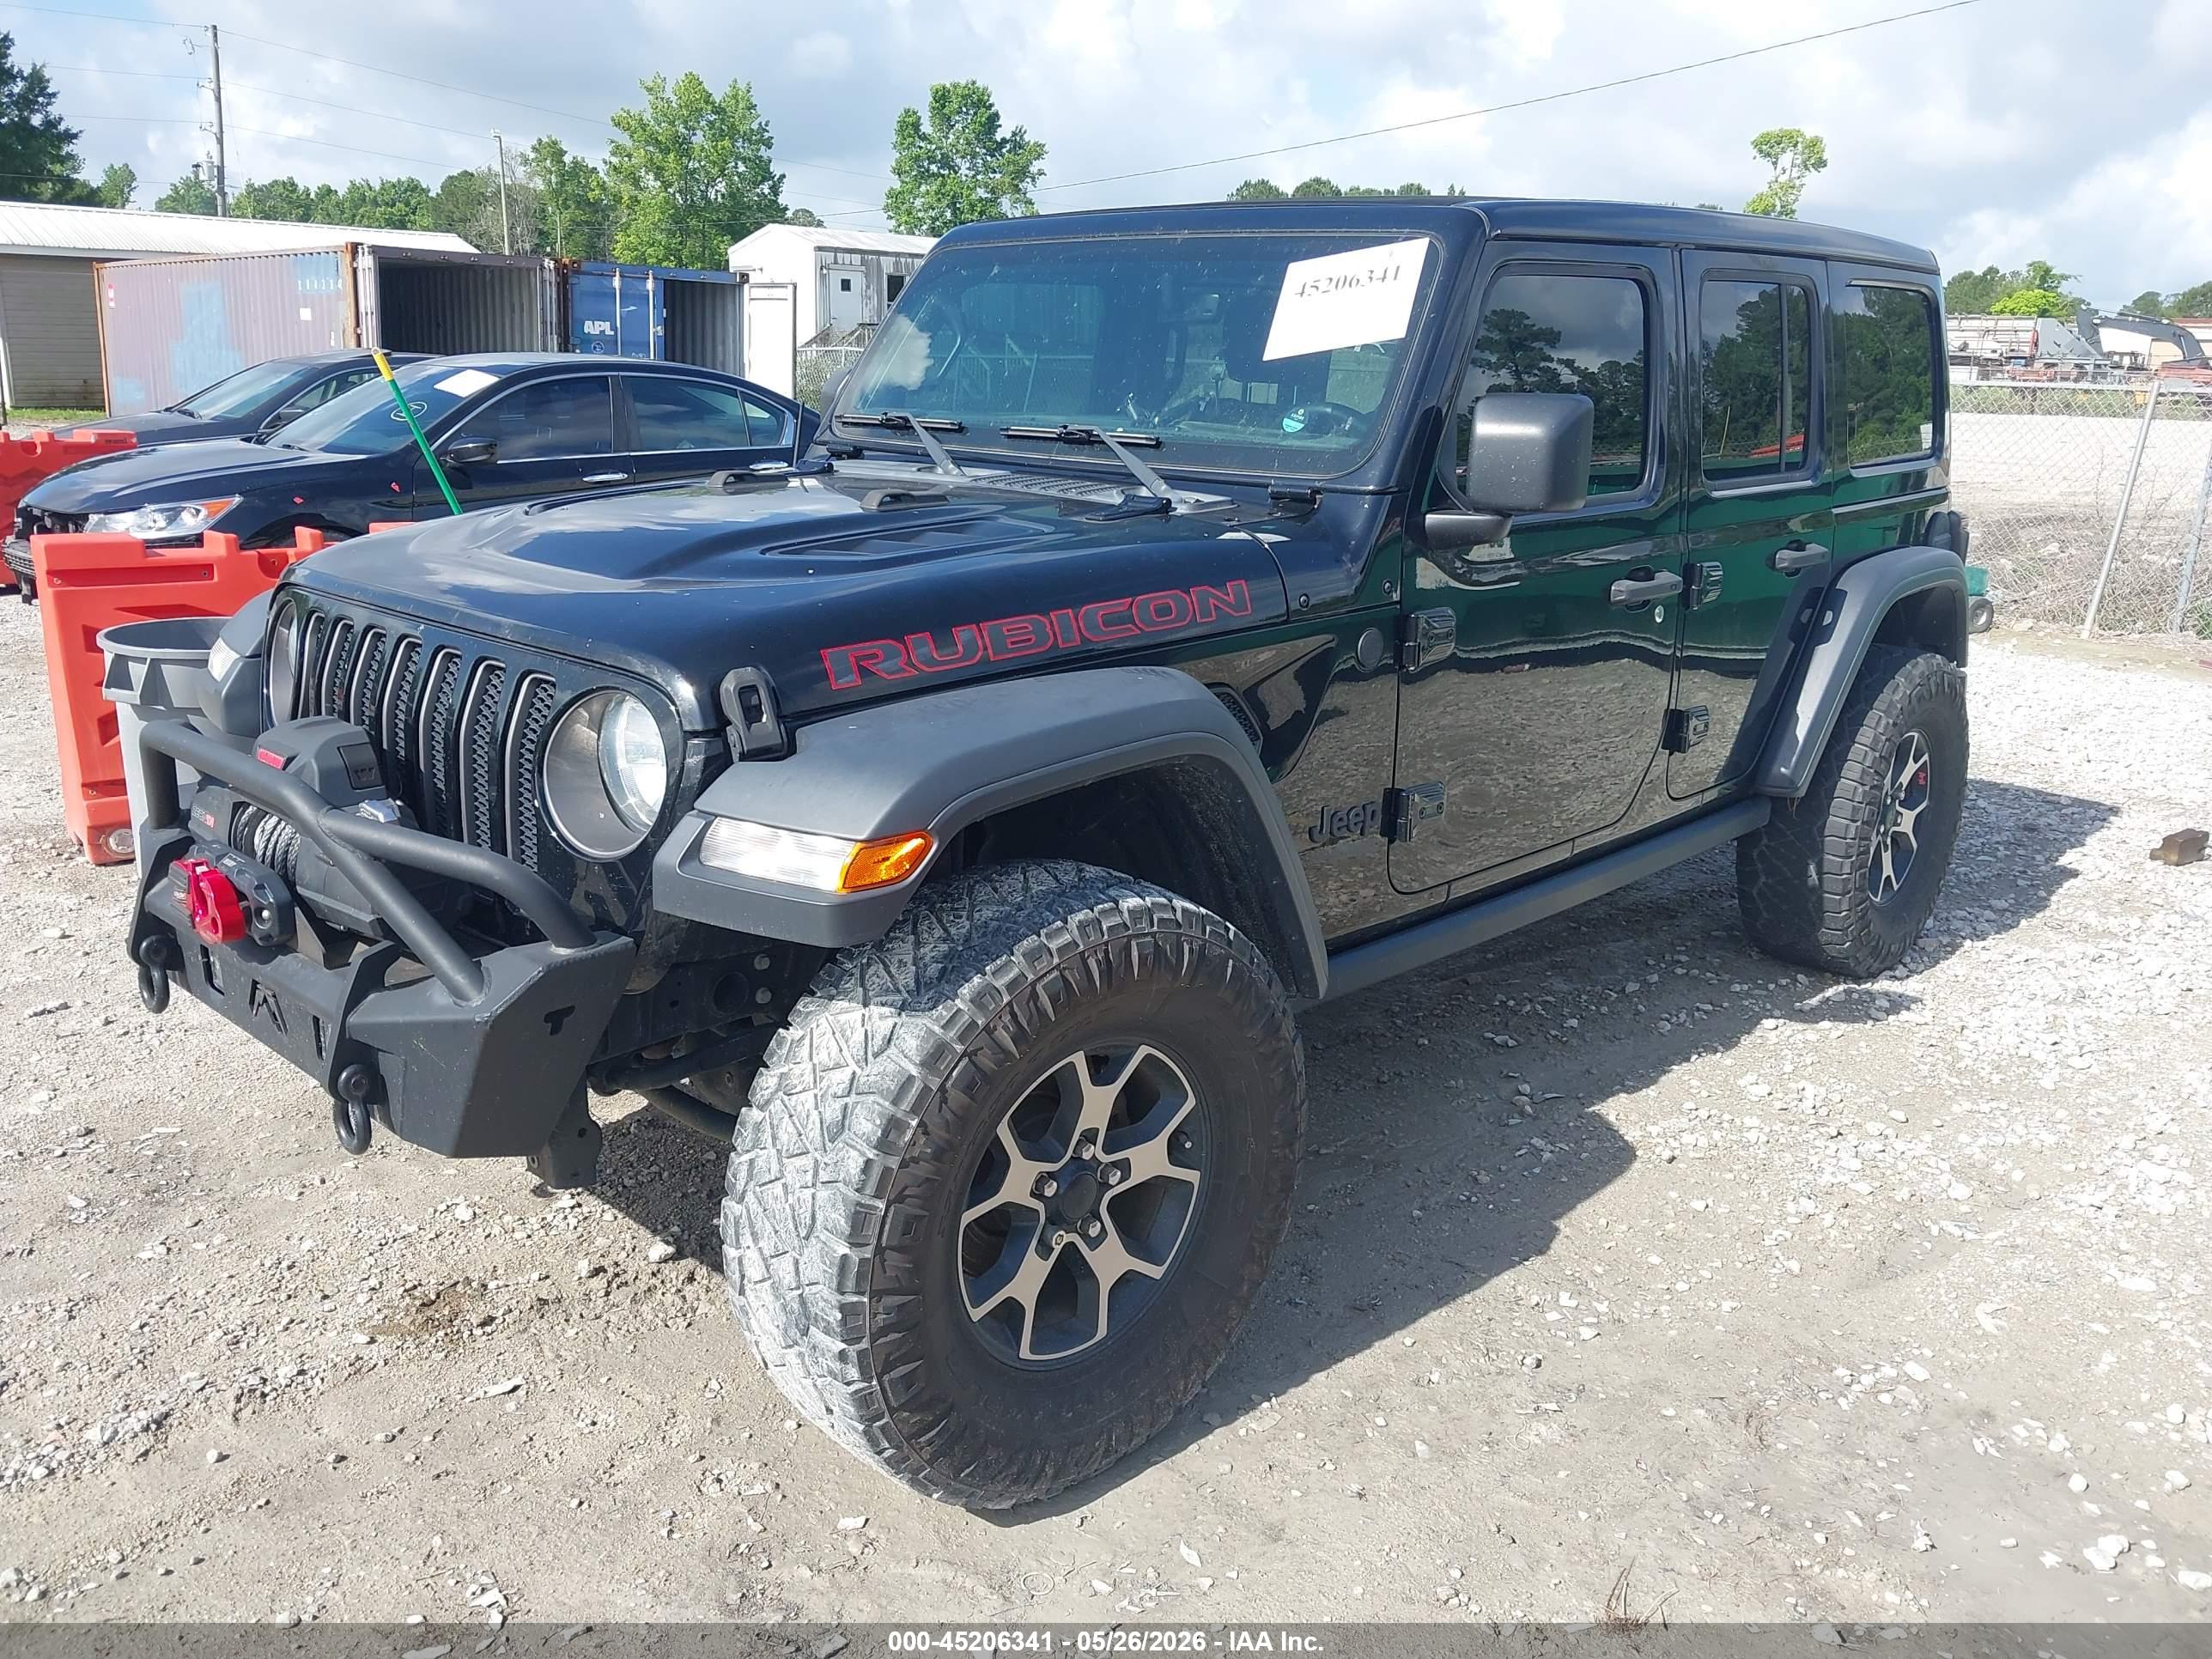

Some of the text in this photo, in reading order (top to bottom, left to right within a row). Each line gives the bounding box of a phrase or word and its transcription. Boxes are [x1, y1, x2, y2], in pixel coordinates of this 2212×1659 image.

[1294, 264, 1401, 298] 45206341
[584, 320, 614, 335] APL
[820, 580, 1252, 690] RUBICON
[1308, 801, 1382, 843] Jeep
